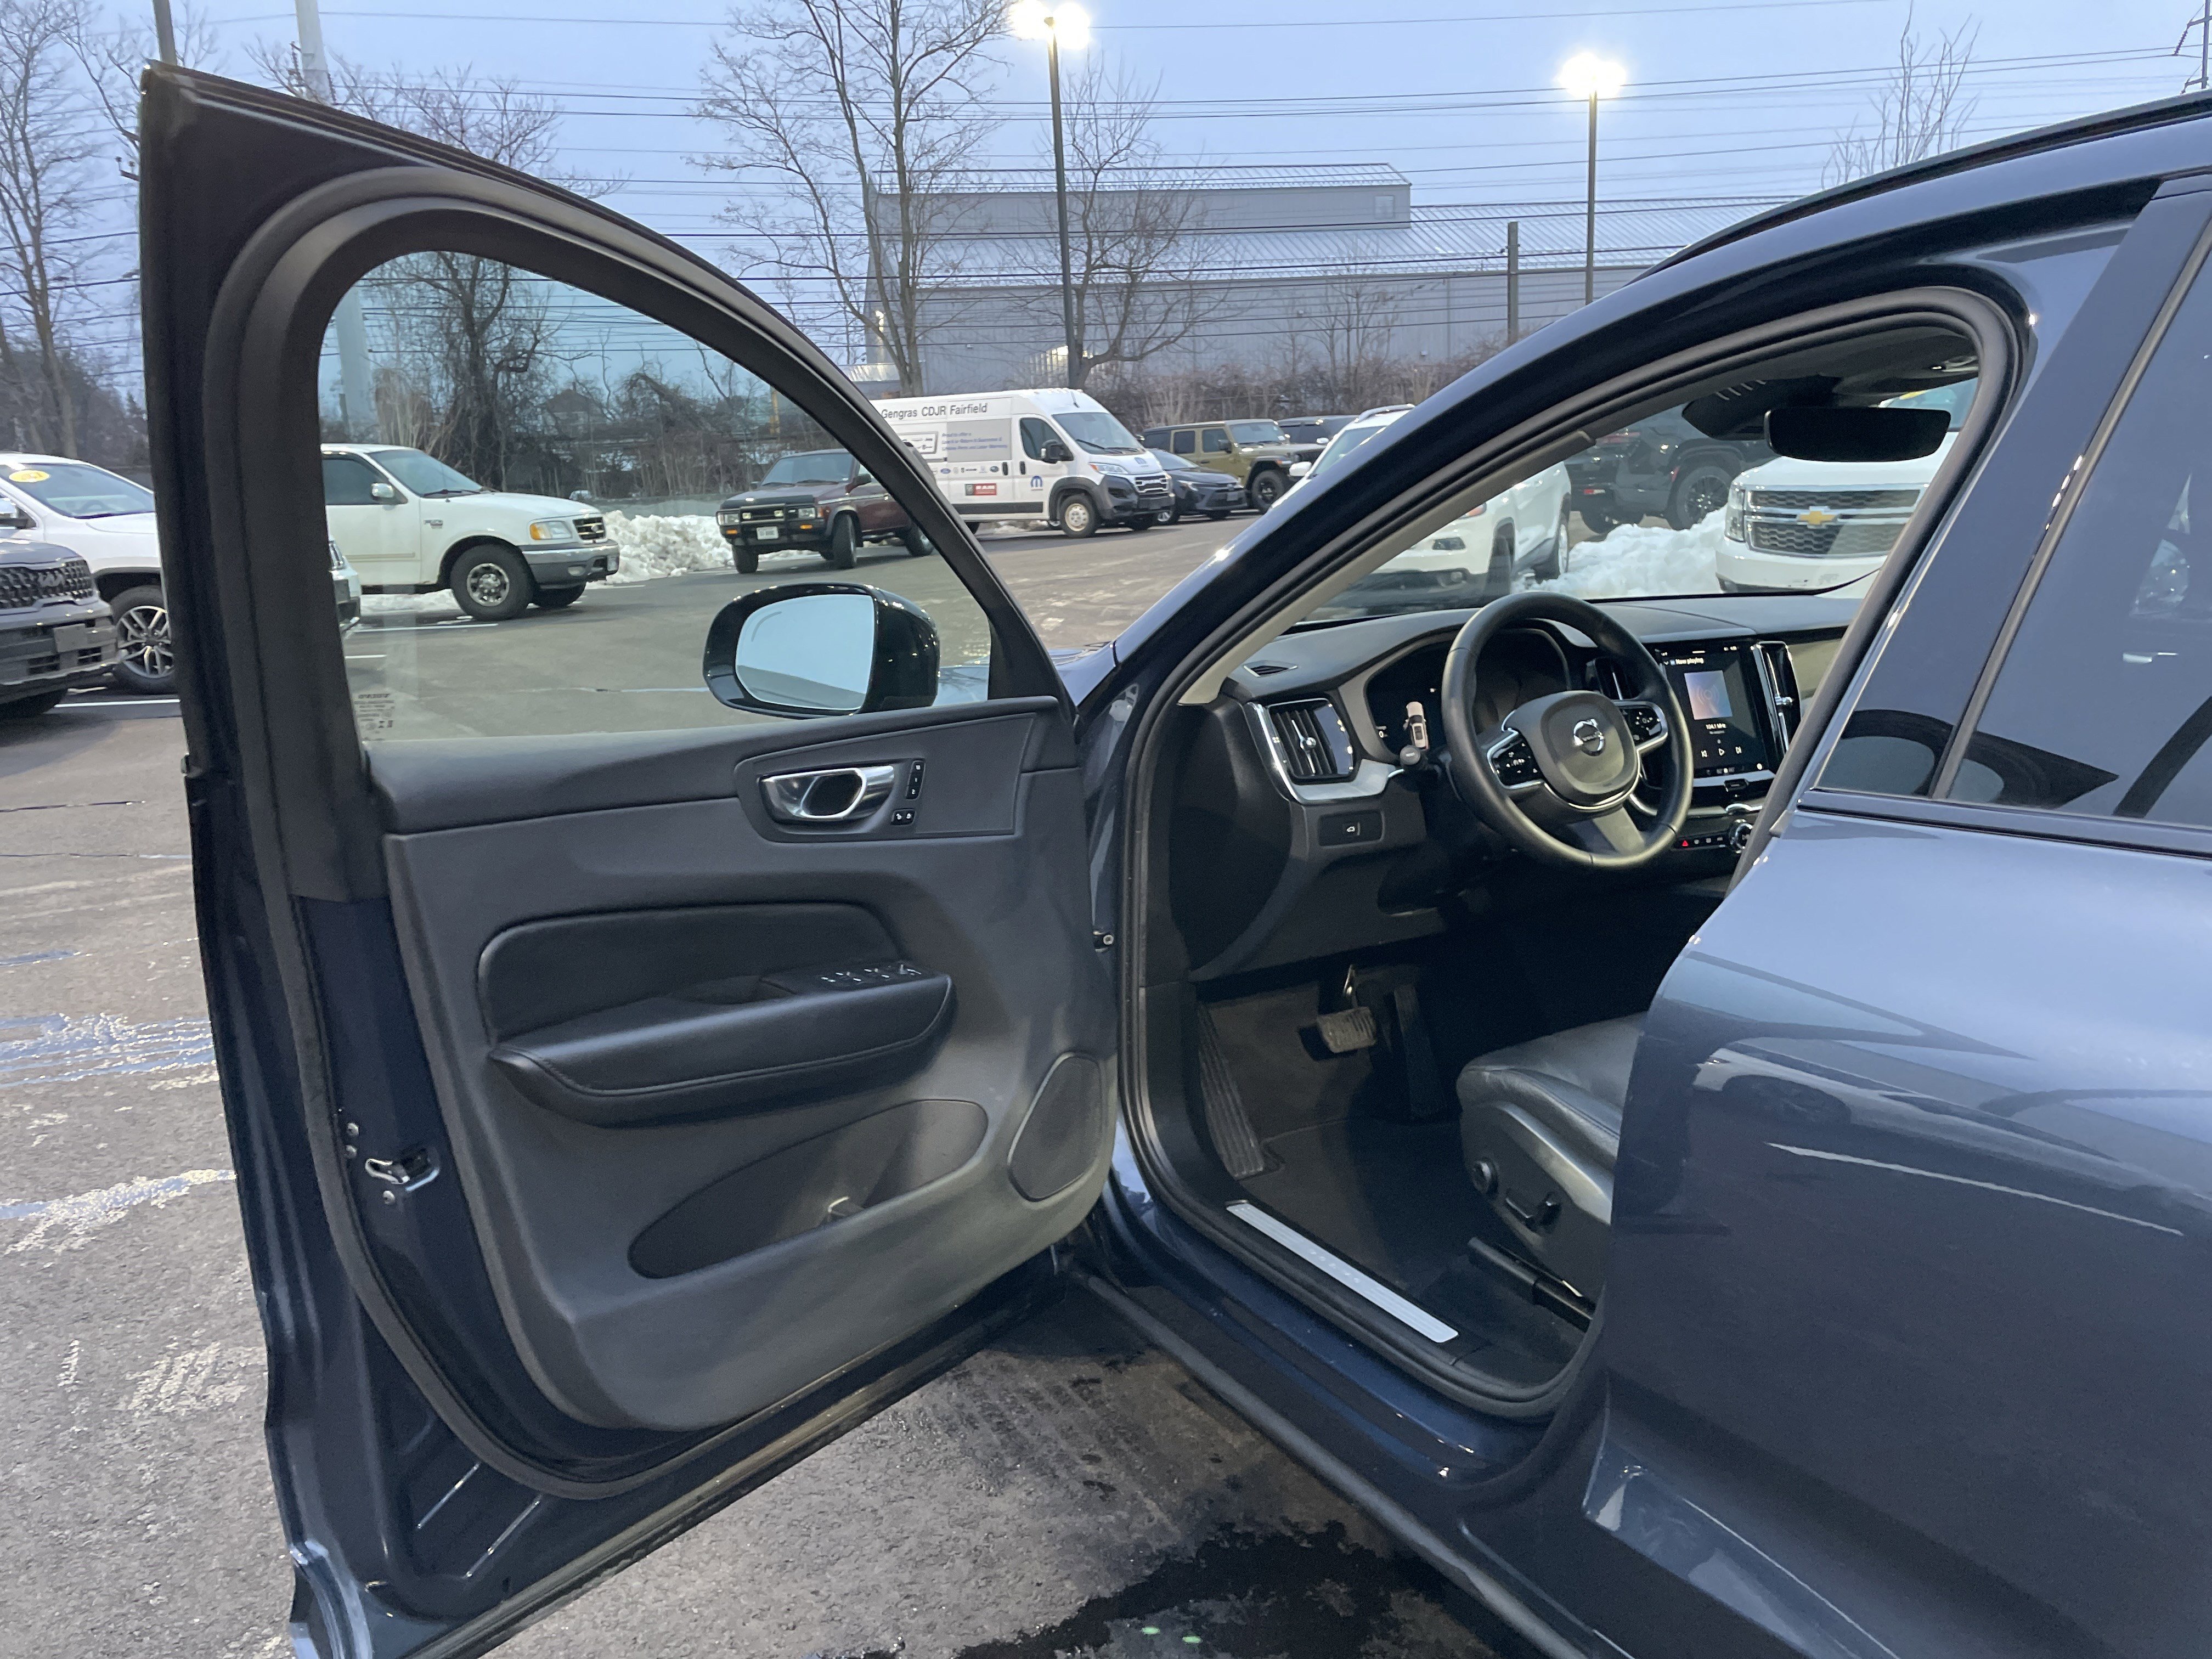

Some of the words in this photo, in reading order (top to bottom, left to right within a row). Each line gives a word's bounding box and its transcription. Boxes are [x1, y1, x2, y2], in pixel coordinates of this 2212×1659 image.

[881, 409, 918, 420] Gengras
[921, 405, 946, 416] CDJR
[950, 403, 987, 415] Fairfield
